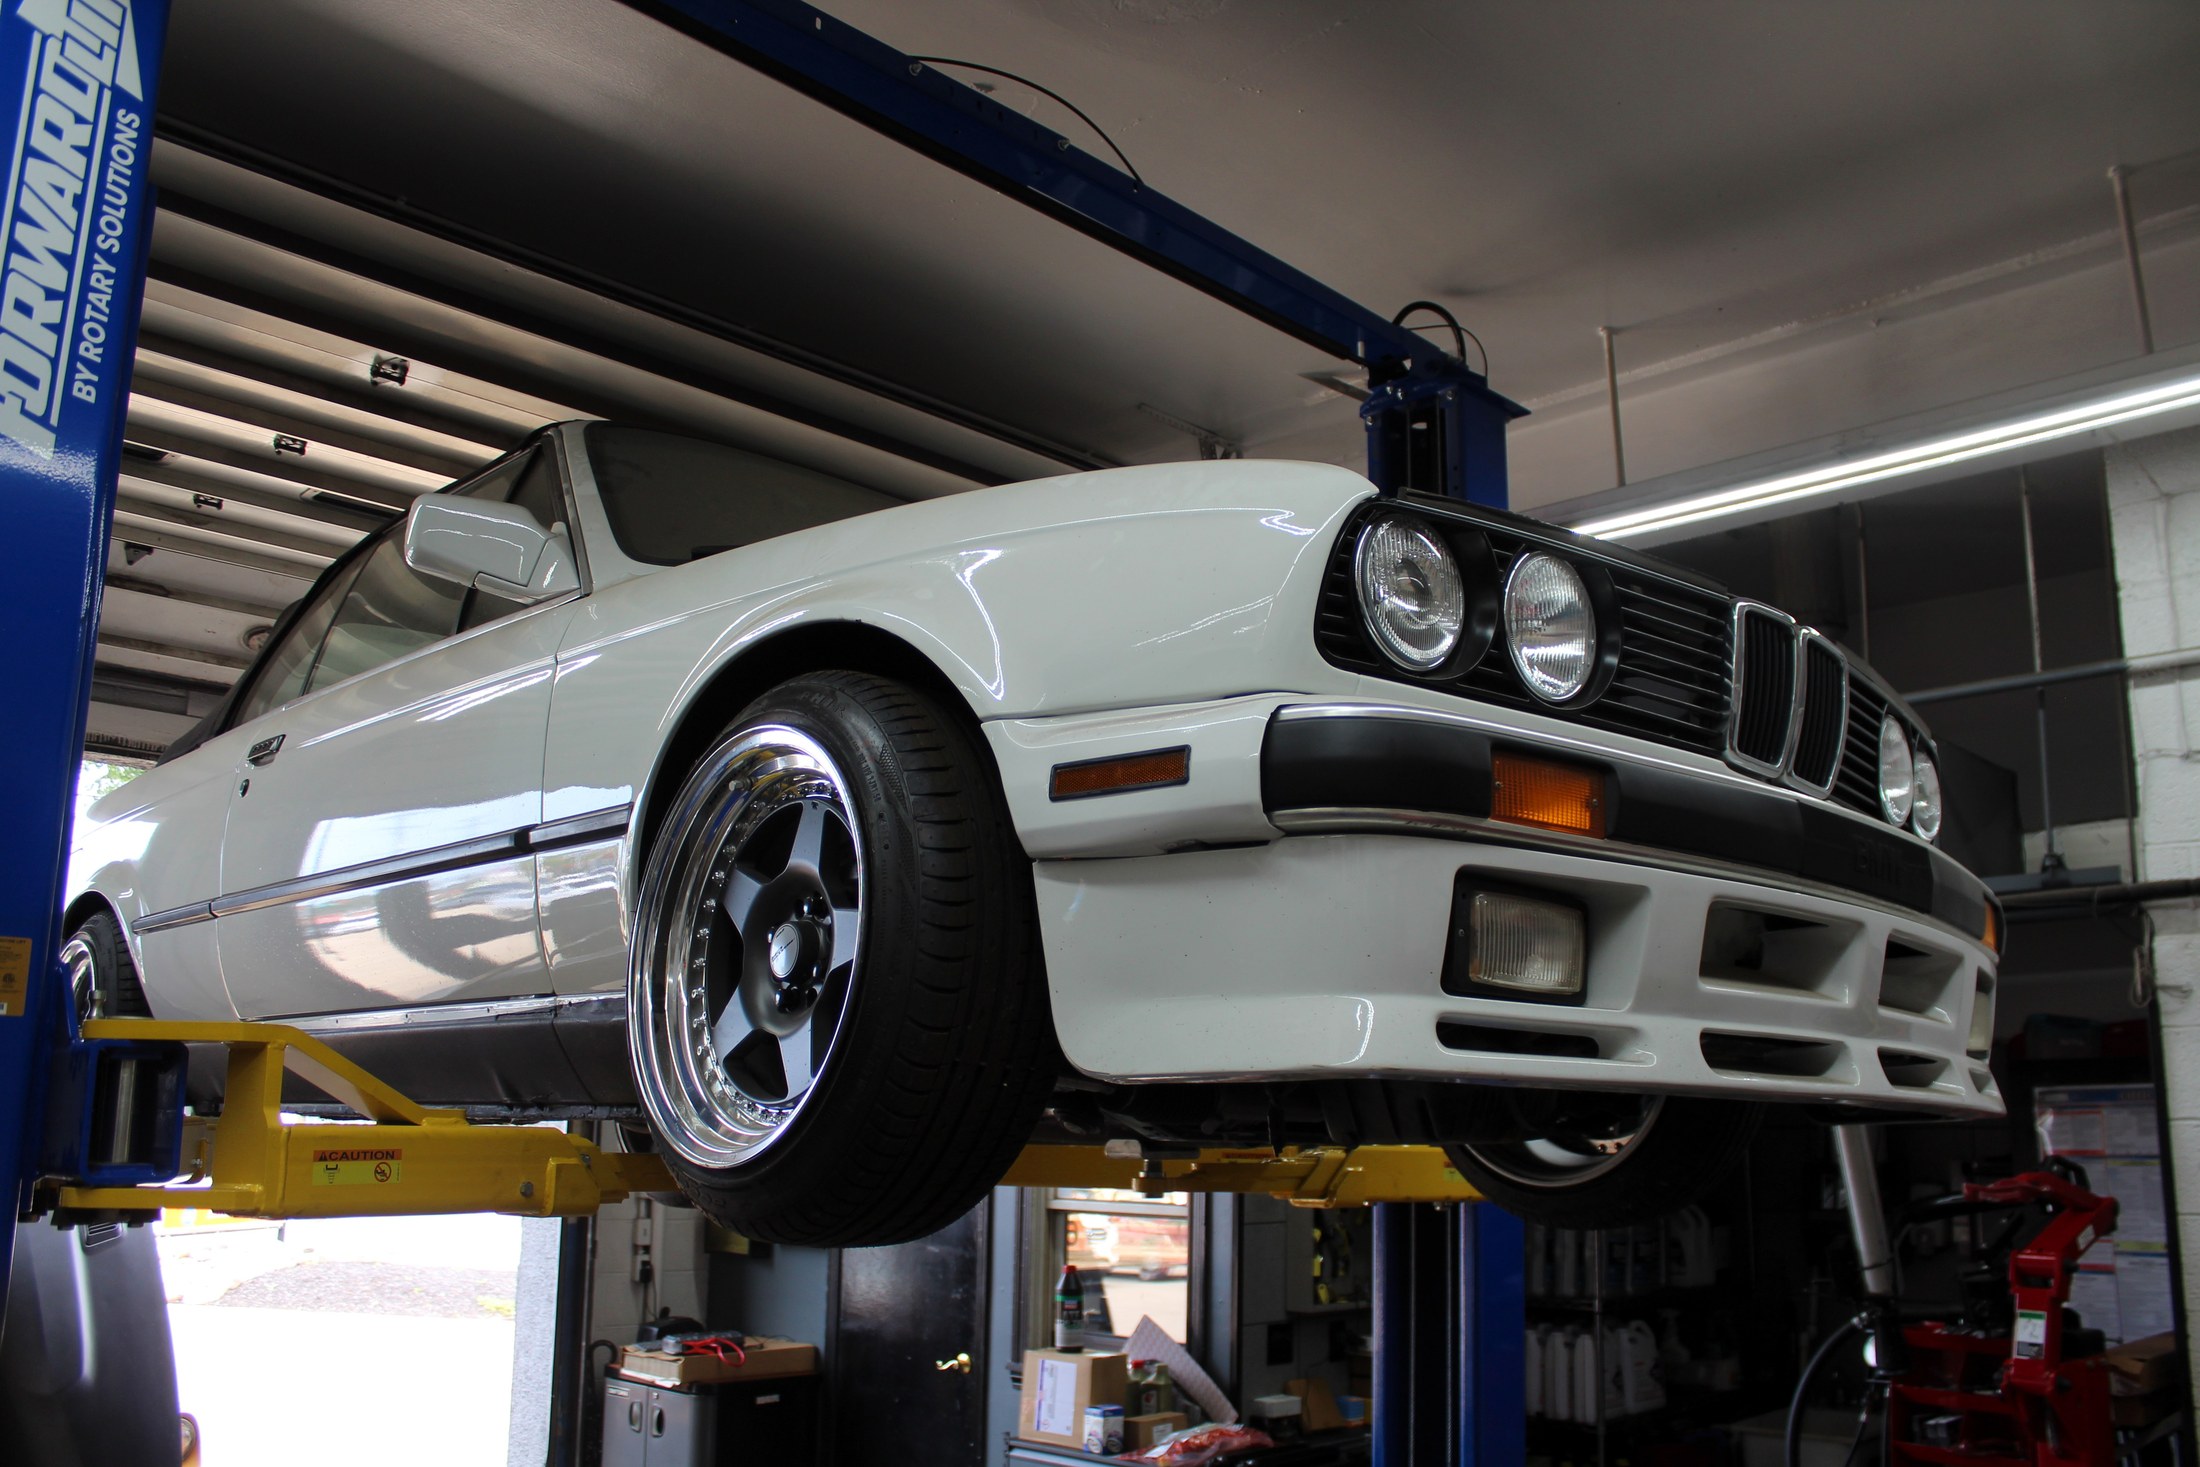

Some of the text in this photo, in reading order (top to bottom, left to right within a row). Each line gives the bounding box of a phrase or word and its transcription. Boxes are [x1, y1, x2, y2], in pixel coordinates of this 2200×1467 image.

[72, 108, 141, 404] BY ROTARY SOLUTIONS
[329, 1150, 395, 1161] CAUTION
